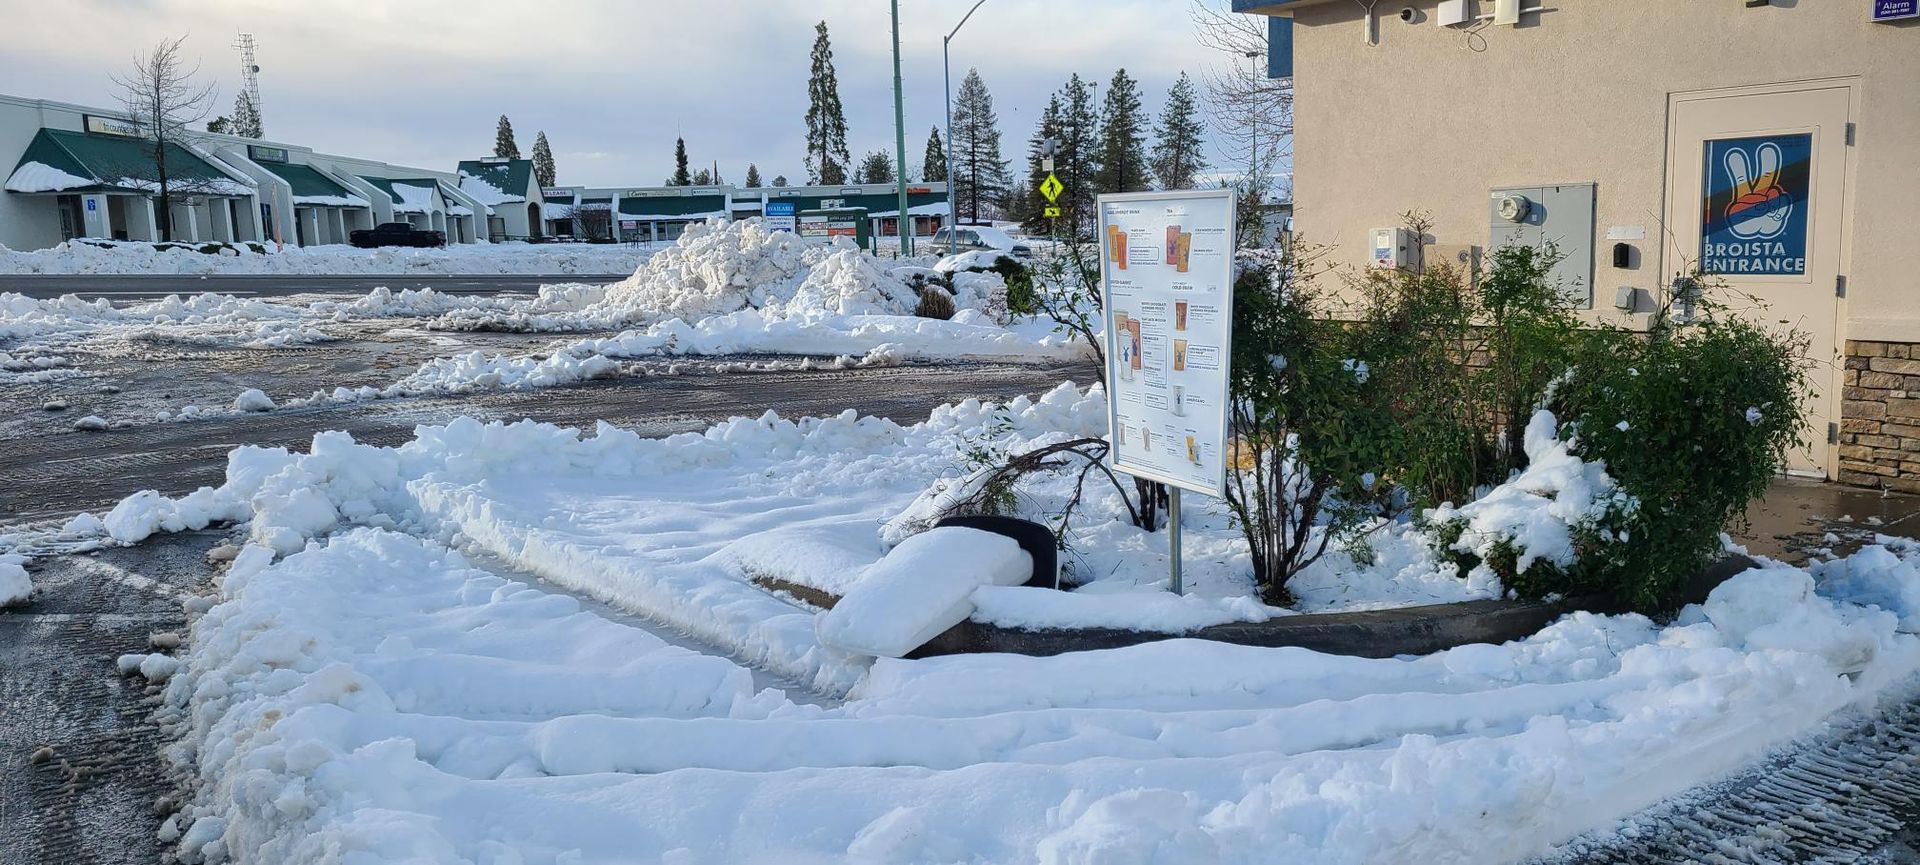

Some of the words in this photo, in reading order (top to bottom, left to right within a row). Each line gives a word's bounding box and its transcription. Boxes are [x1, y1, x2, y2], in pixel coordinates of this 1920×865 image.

[1882, 1, 1910, 10] Alarm
[1704, 242, 1787, 257] BROISTA
[1704, 258, 1804, 273] ENTRANCE
